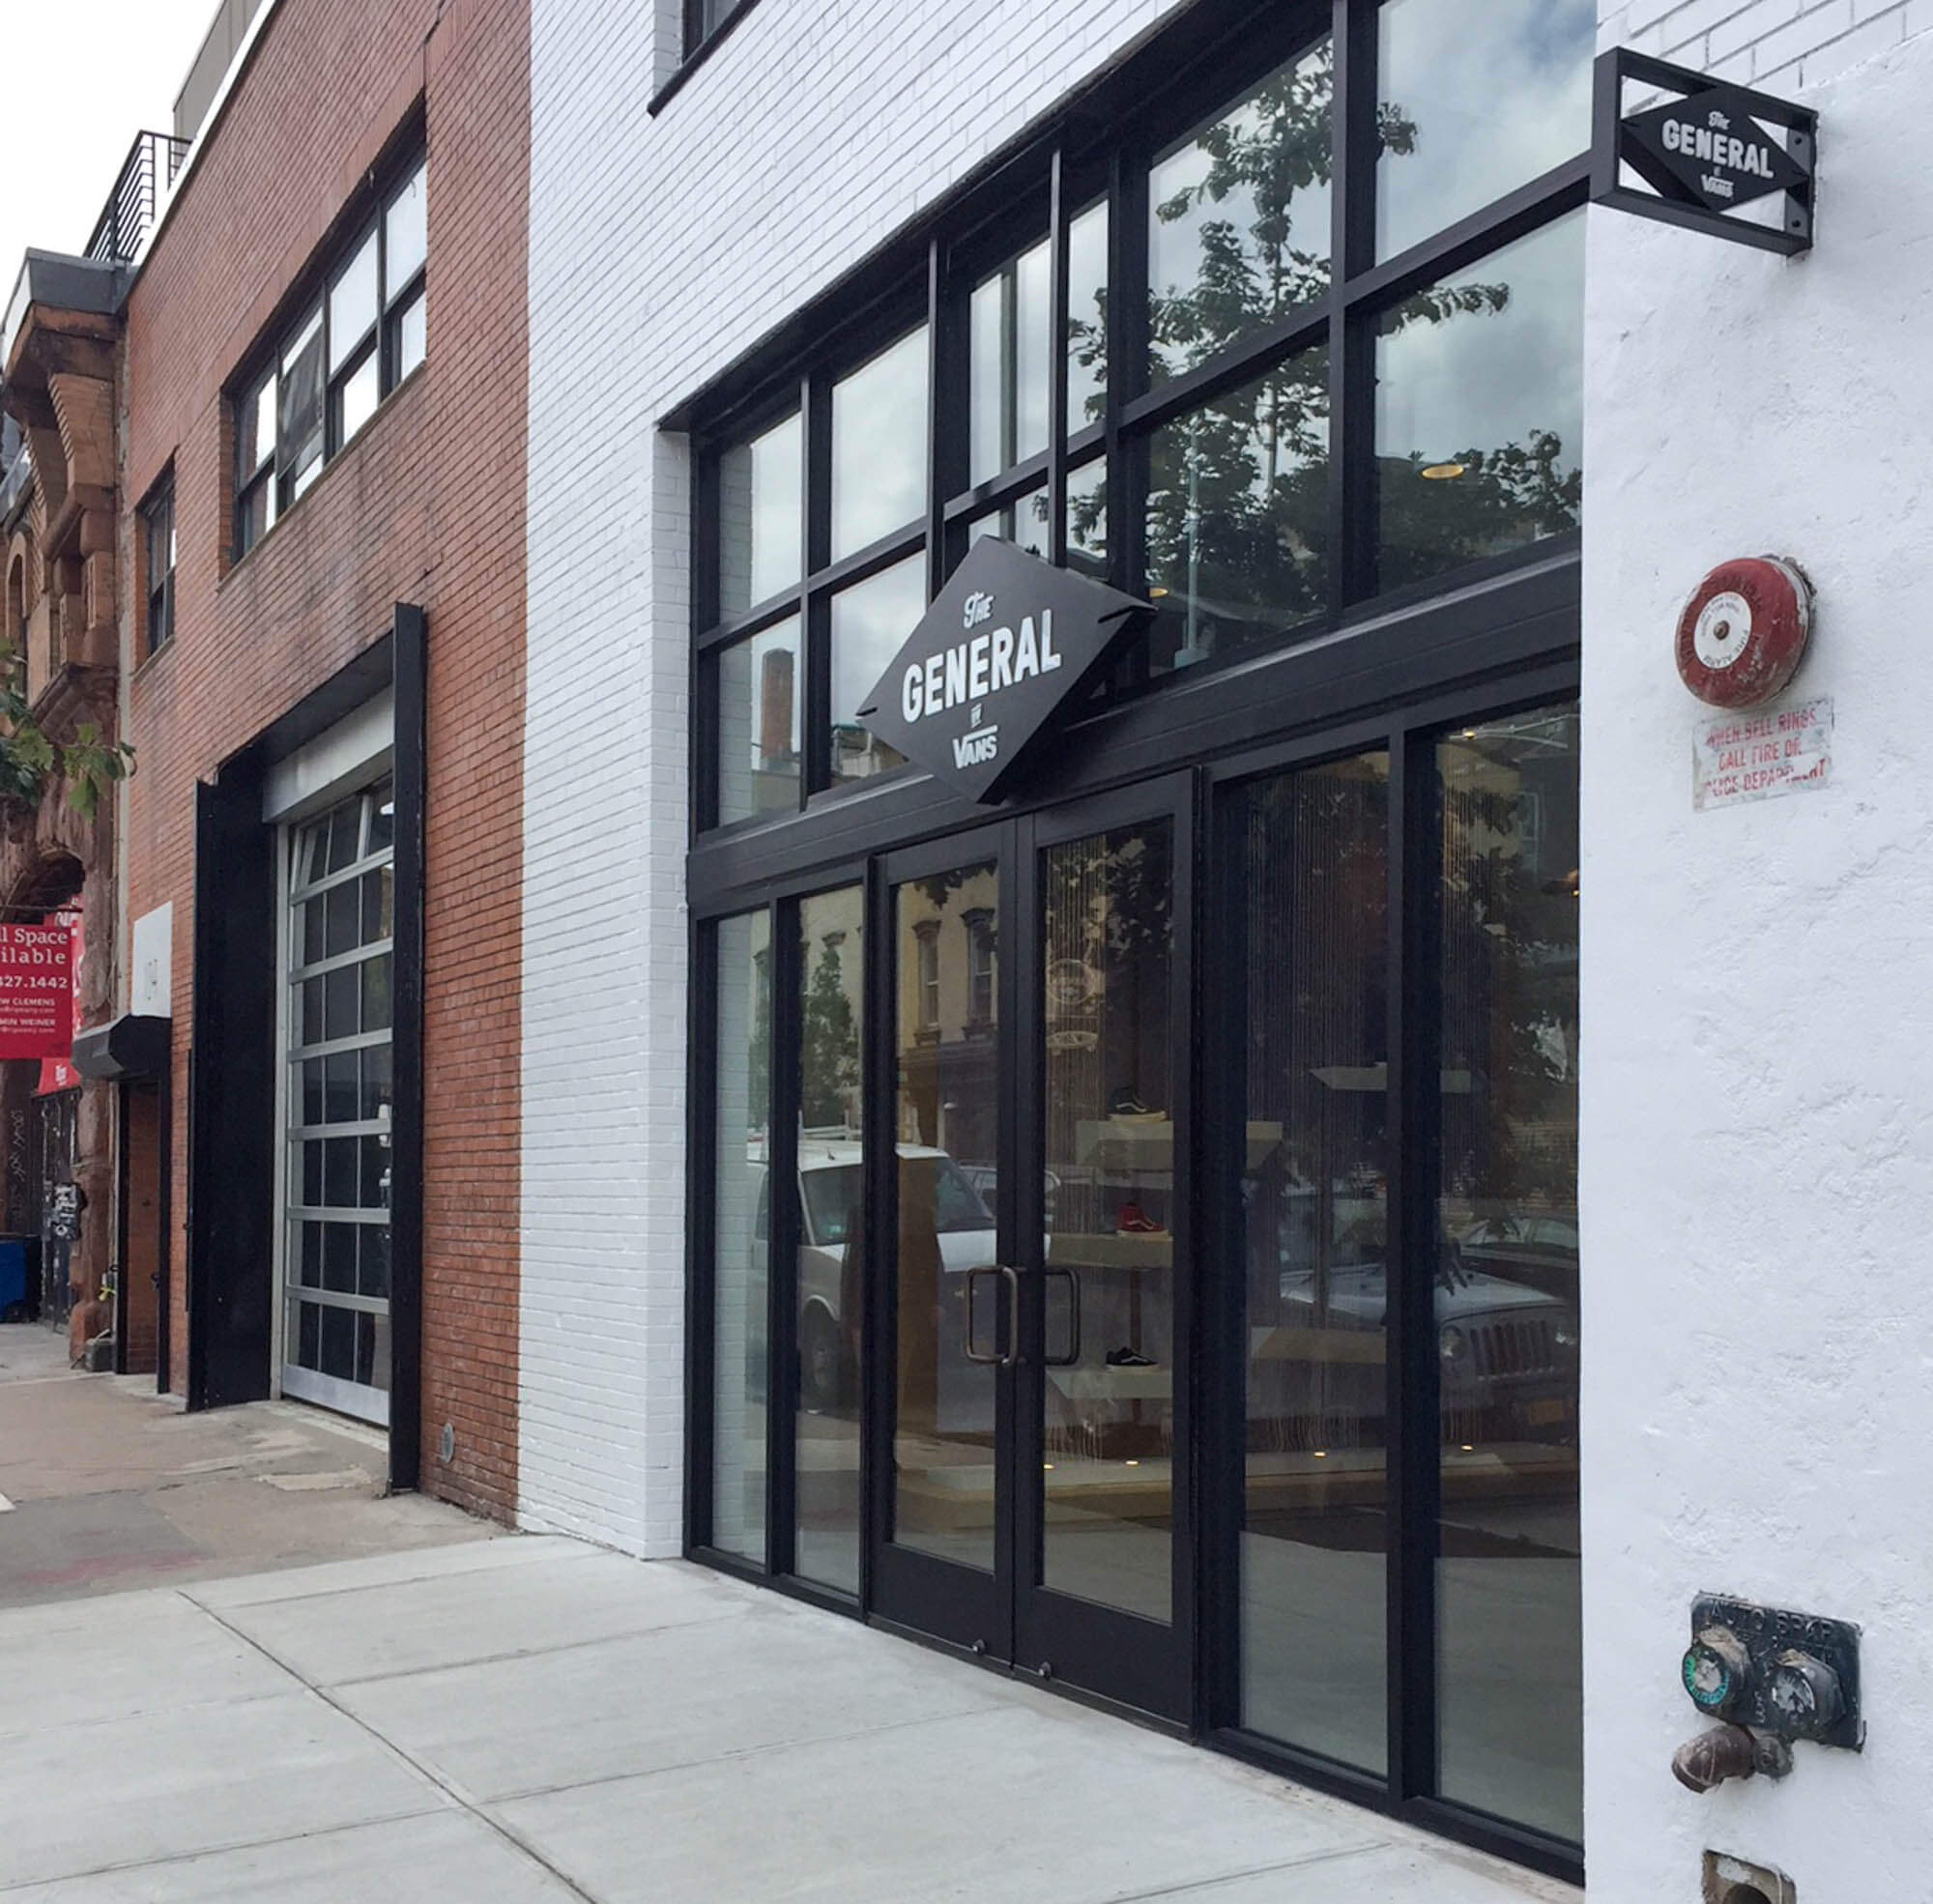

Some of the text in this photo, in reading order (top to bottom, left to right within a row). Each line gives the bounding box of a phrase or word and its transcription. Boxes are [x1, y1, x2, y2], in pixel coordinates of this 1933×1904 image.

[1661, 118, 1774, 180] GENERAL
[902, 609, 1061, 723] GENERAL
[952, 725, 997, 769] VANS
[1718, 748, 1746, 772] CALL
[1751, 741, 1781, 765] FIRE
[14, 928, 69, 947] Space
[1, 947, 67, 965] ilable
[0, 975, 68, 989] 27.1442
[12, 997, 56, 1006] CLEMENS
[19, 1018, 56, 1026] WEINER
